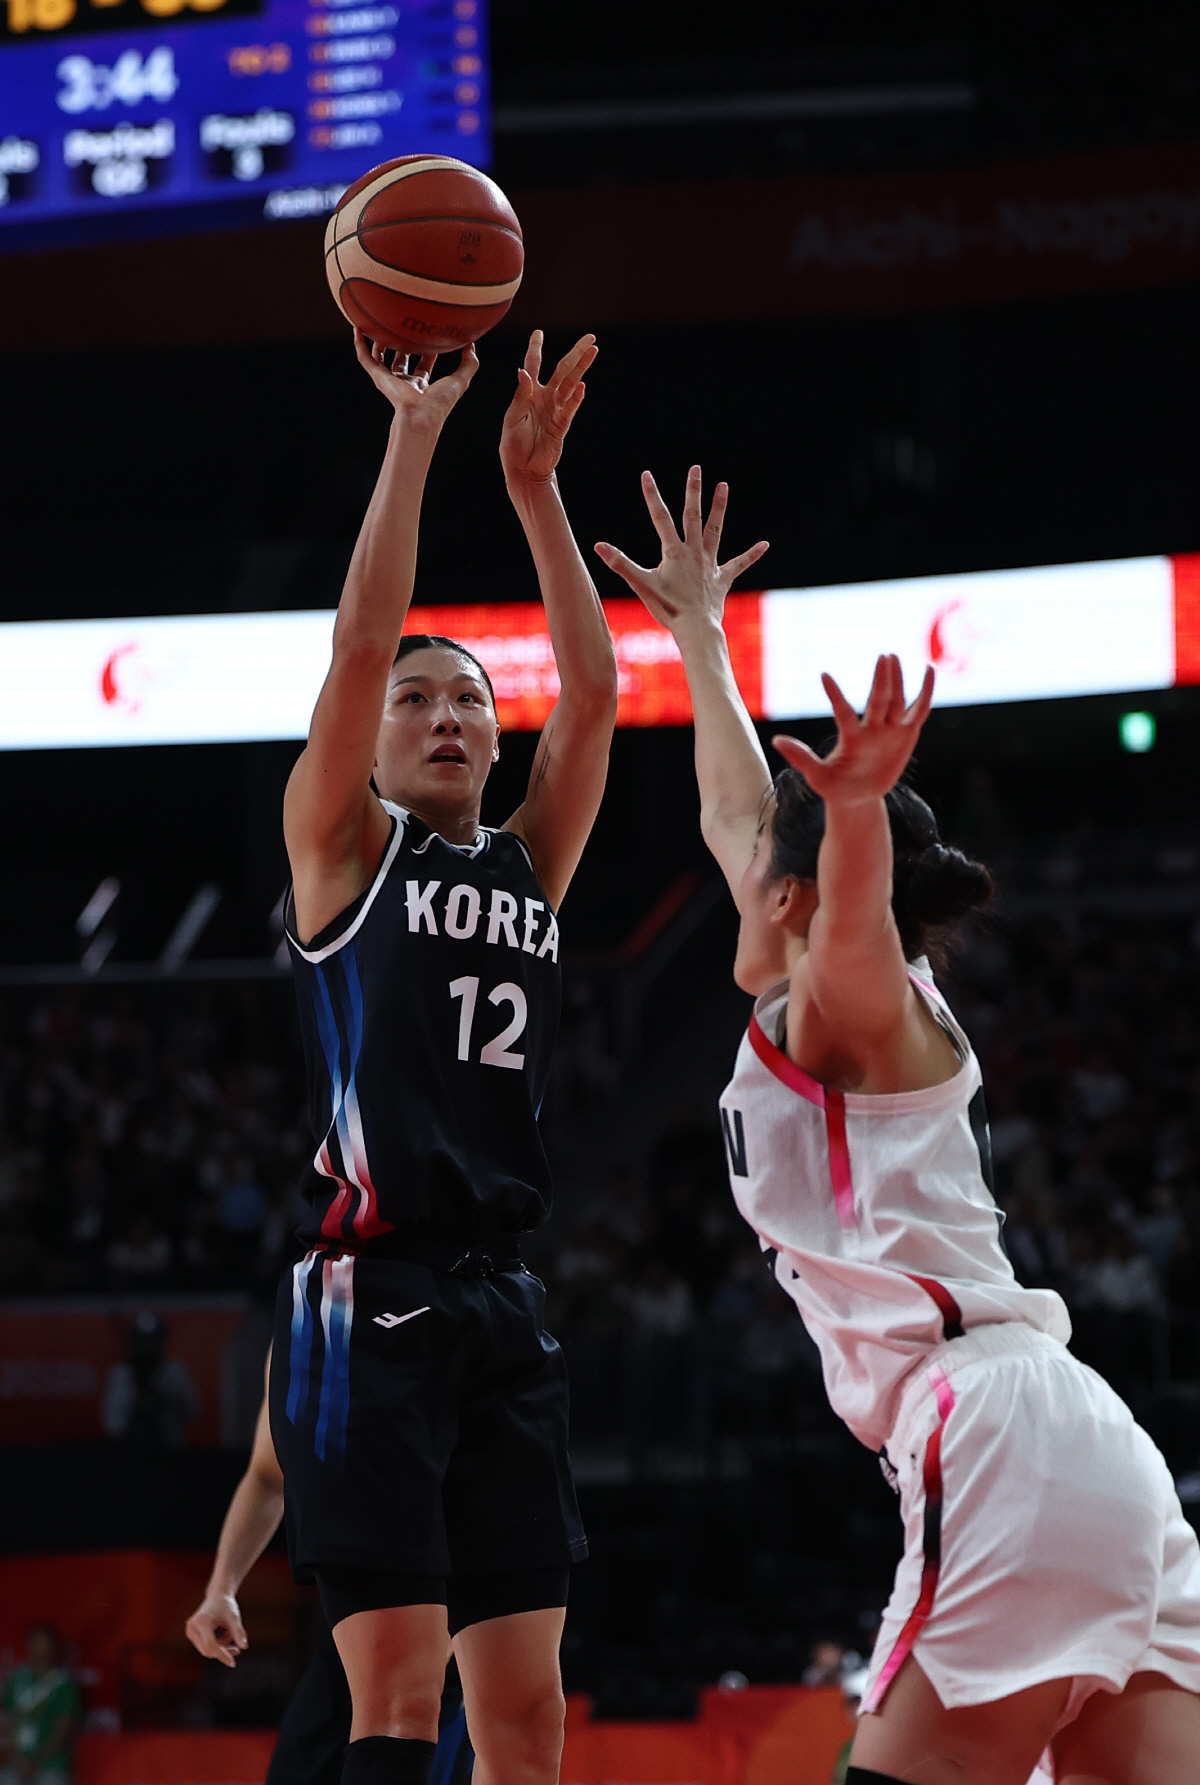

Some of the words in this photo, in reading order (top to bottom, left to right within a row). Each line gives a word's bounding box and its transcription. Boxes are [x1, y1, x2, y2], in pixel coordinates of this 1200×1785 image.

[56, 47, 178, 114] 3:44
[404, 879, 560, 964] KOREA
[449, 975, 528, 1070] 12
